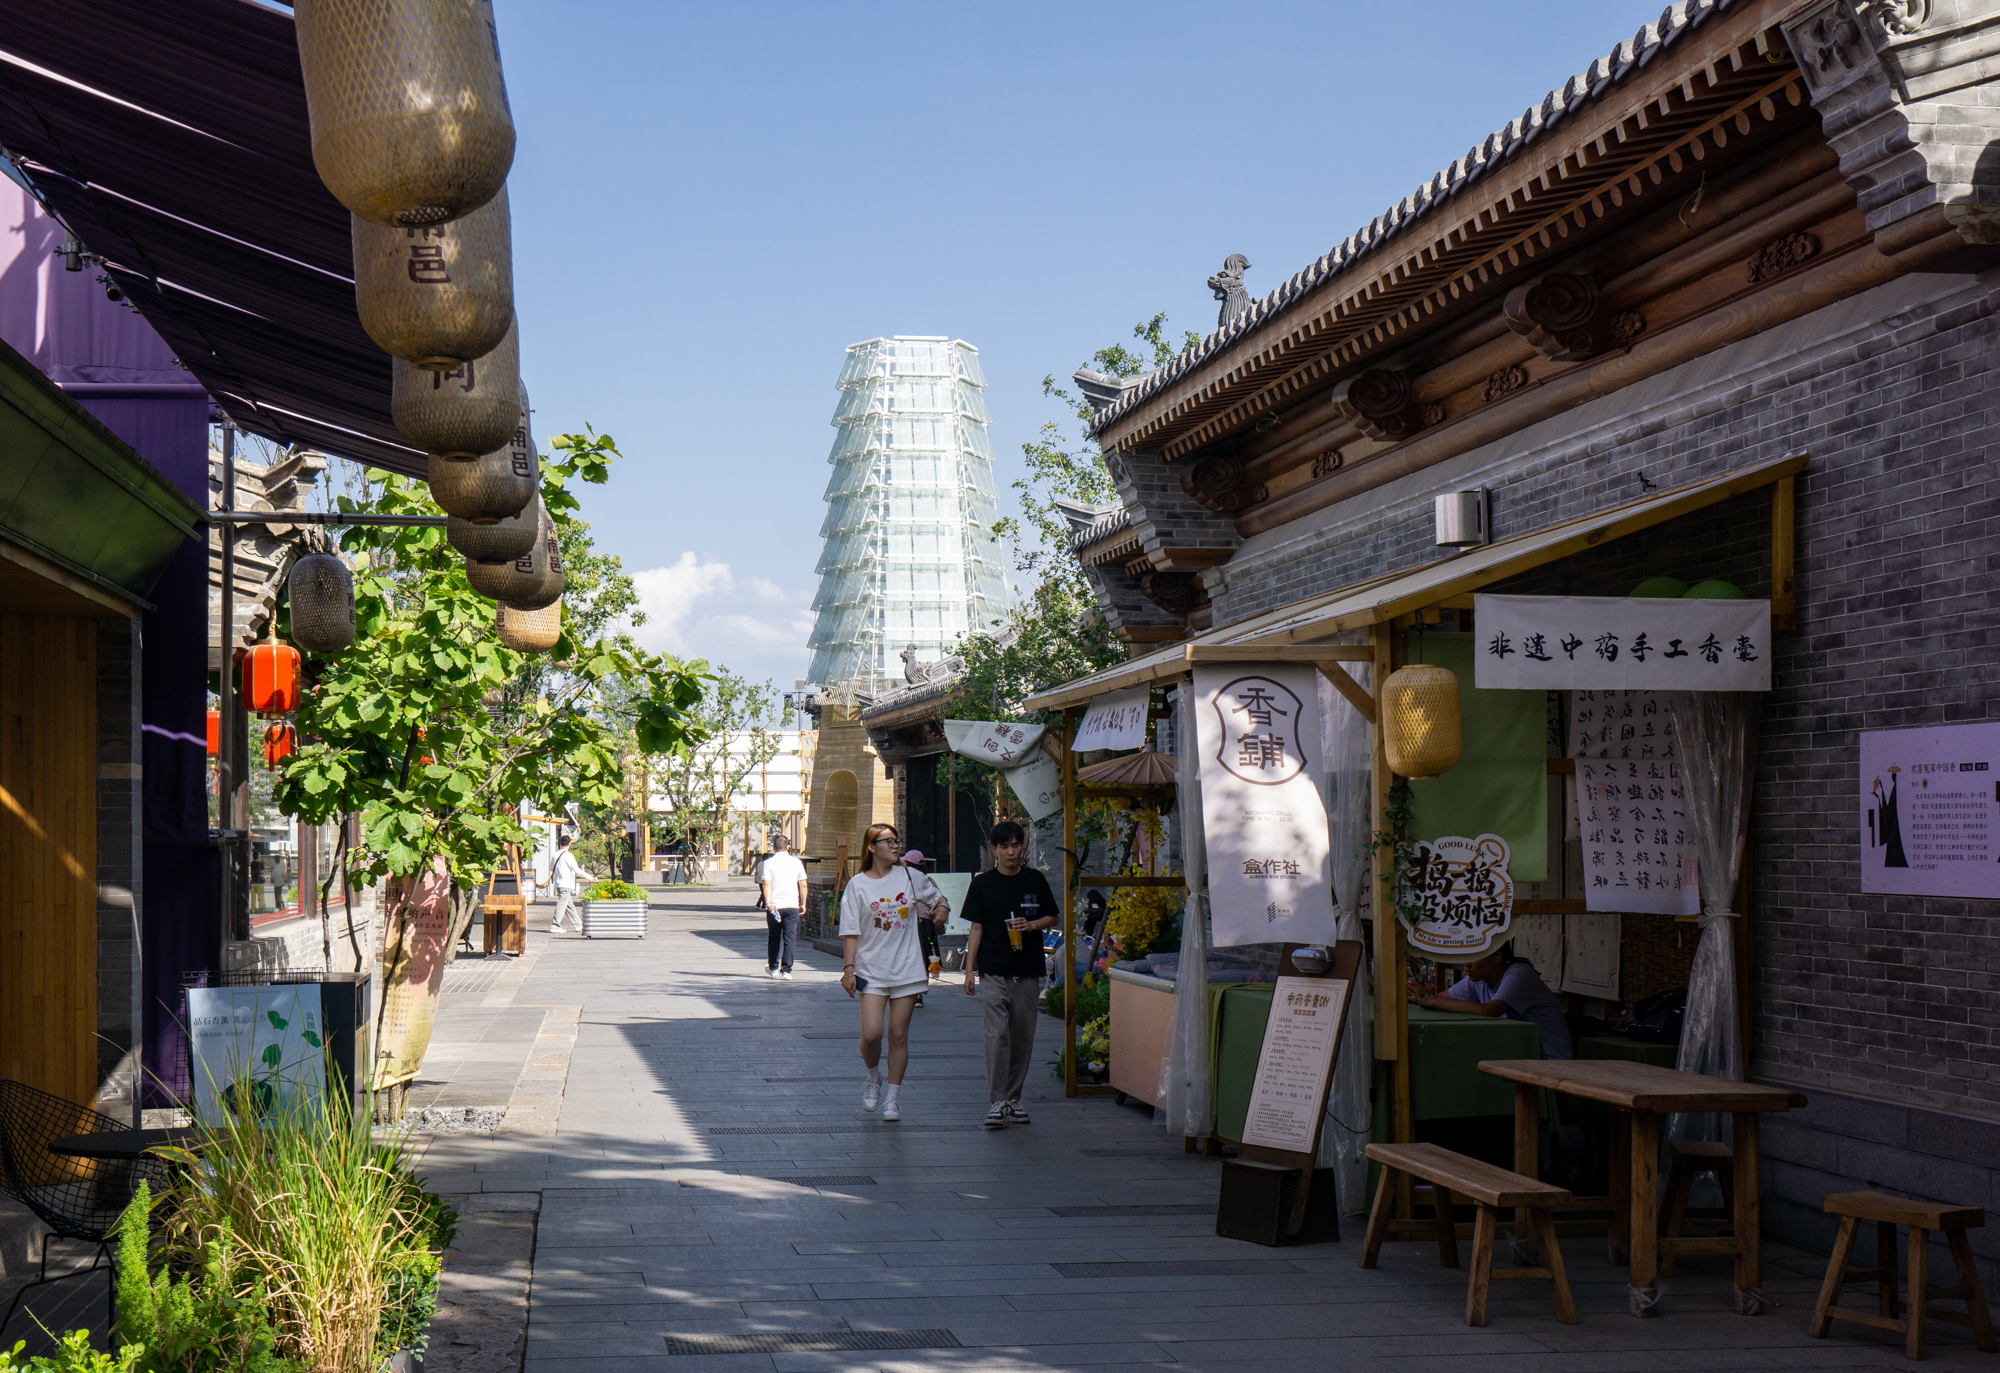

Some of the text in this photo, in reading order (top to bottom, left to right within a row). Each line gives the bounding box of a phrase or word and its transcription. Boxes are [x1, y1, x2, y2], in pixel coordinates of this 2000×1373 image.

[1488, 630, 1759, 664] 非遗中药手工香囊
[1438, 841, 1487, 859] GOOD LUCK
[1242, 858, 1302, 875] 盒作社
[1407, 846, 1502, 897] 捣一捣
[1413, 893, 1506, 930] 没烦恼
[1417, 932, 1427, 941] My
